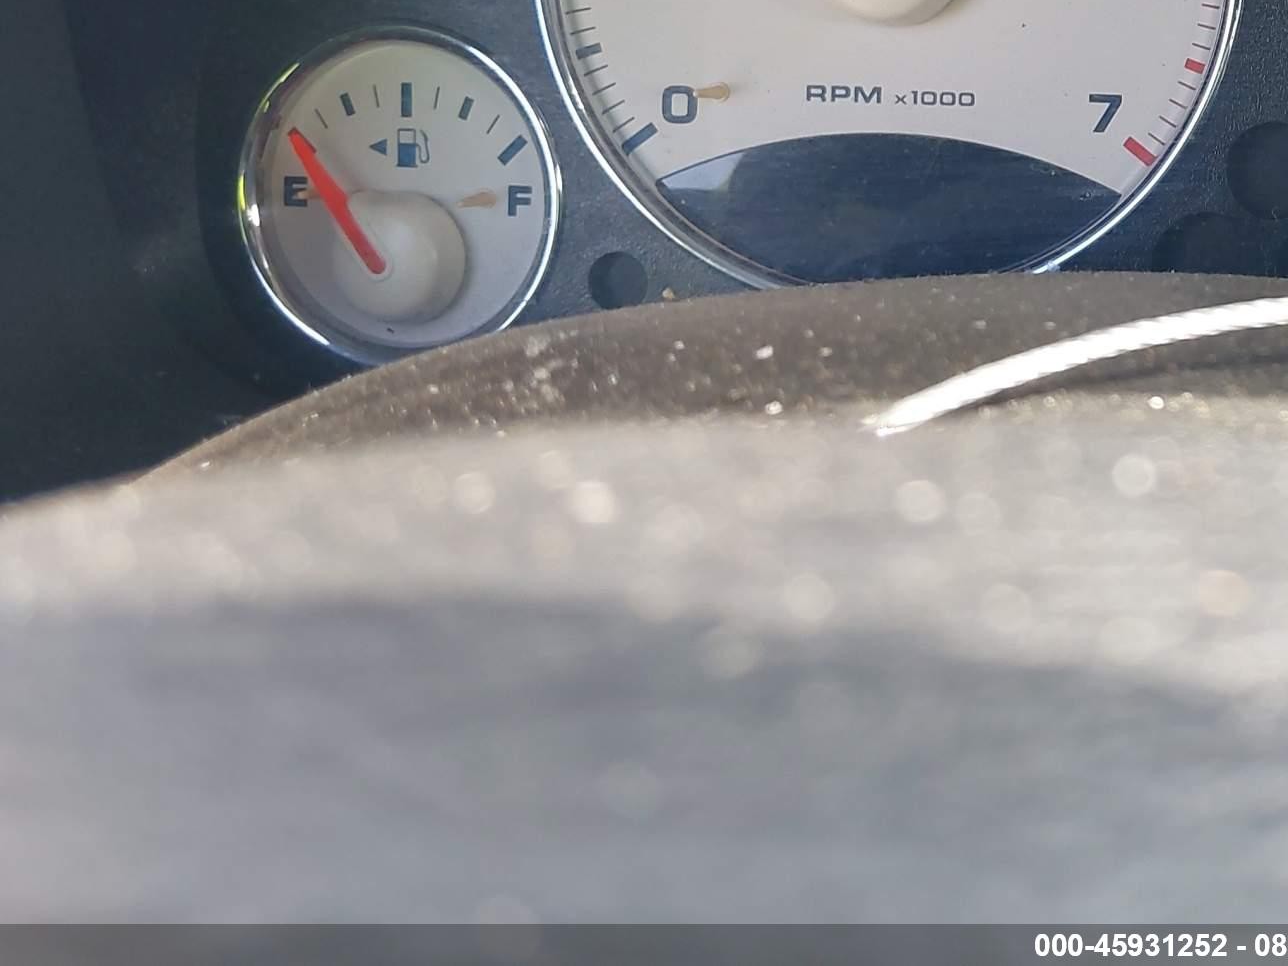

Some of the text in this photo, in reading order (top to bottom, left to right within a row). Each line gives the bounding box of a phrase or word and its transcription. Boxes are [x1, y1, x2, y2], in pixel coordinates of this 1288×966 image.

[661, 85, 698, 124] 0
[805, 84, 976, 109] RPM x1000
[1088, 93, 1123, 134] 7
[284, 176, 308, 208] E
[507, 184, 533, 216] F
